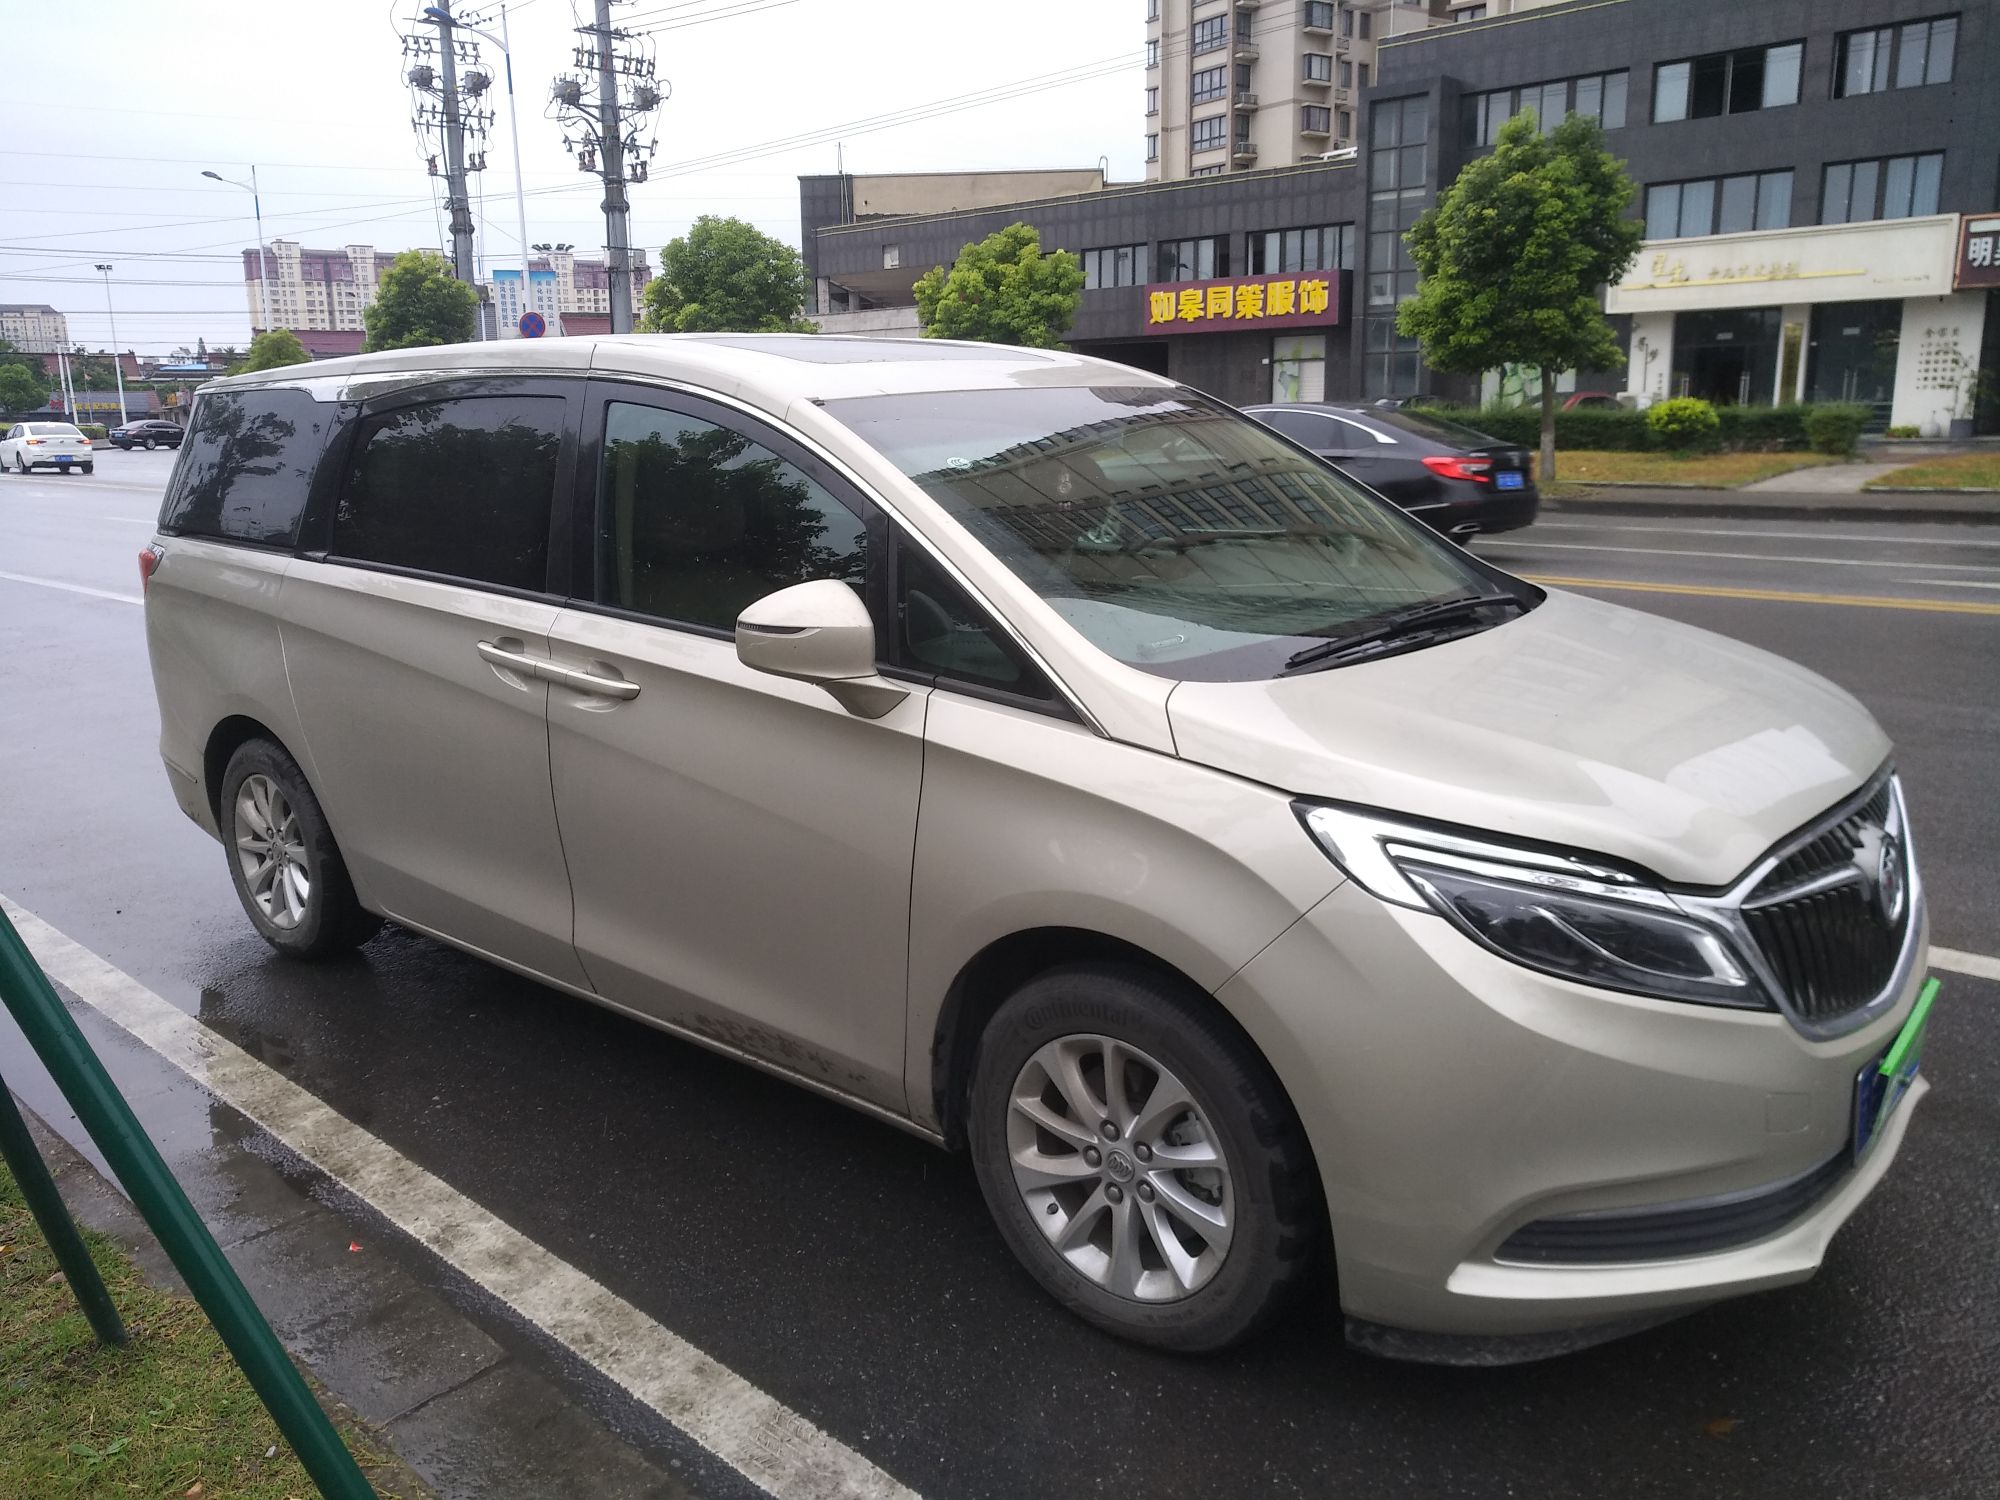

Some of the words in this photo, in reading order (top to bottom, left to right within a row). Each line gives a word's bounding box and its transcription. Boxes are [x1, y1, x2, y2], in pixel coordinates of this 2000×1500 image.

[1149, 278, 1330, 325] 如皋同策服饰
